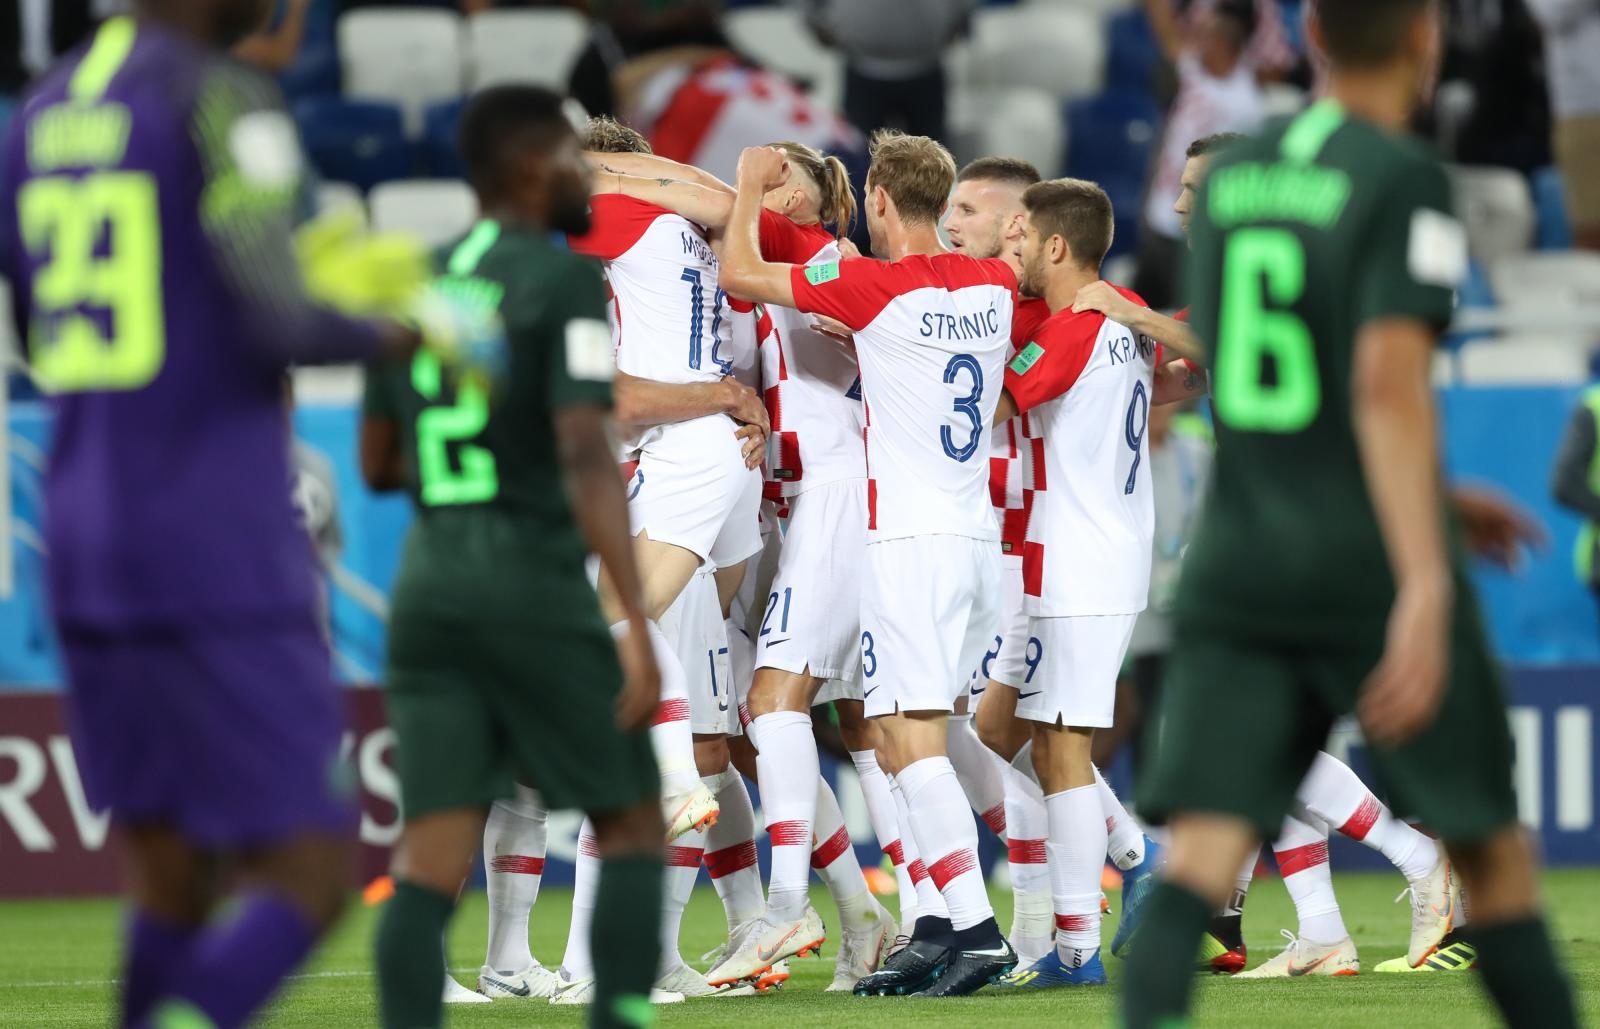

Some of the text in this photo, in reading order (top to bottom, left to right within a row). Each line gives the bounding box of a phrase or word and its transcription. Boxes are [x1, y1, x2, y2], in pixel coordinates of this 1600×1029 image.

[920, 301, 999, 340] STRINIĆ
[1215, 231, 1322, 431] 6
[940, 353, 983, 463] 3
[1125, 379, 1147, 495] 9
[760, 587, 792, 637] 21
[861, 630, 877, 678] 3
[1024, 636, 1043, 684] 9
